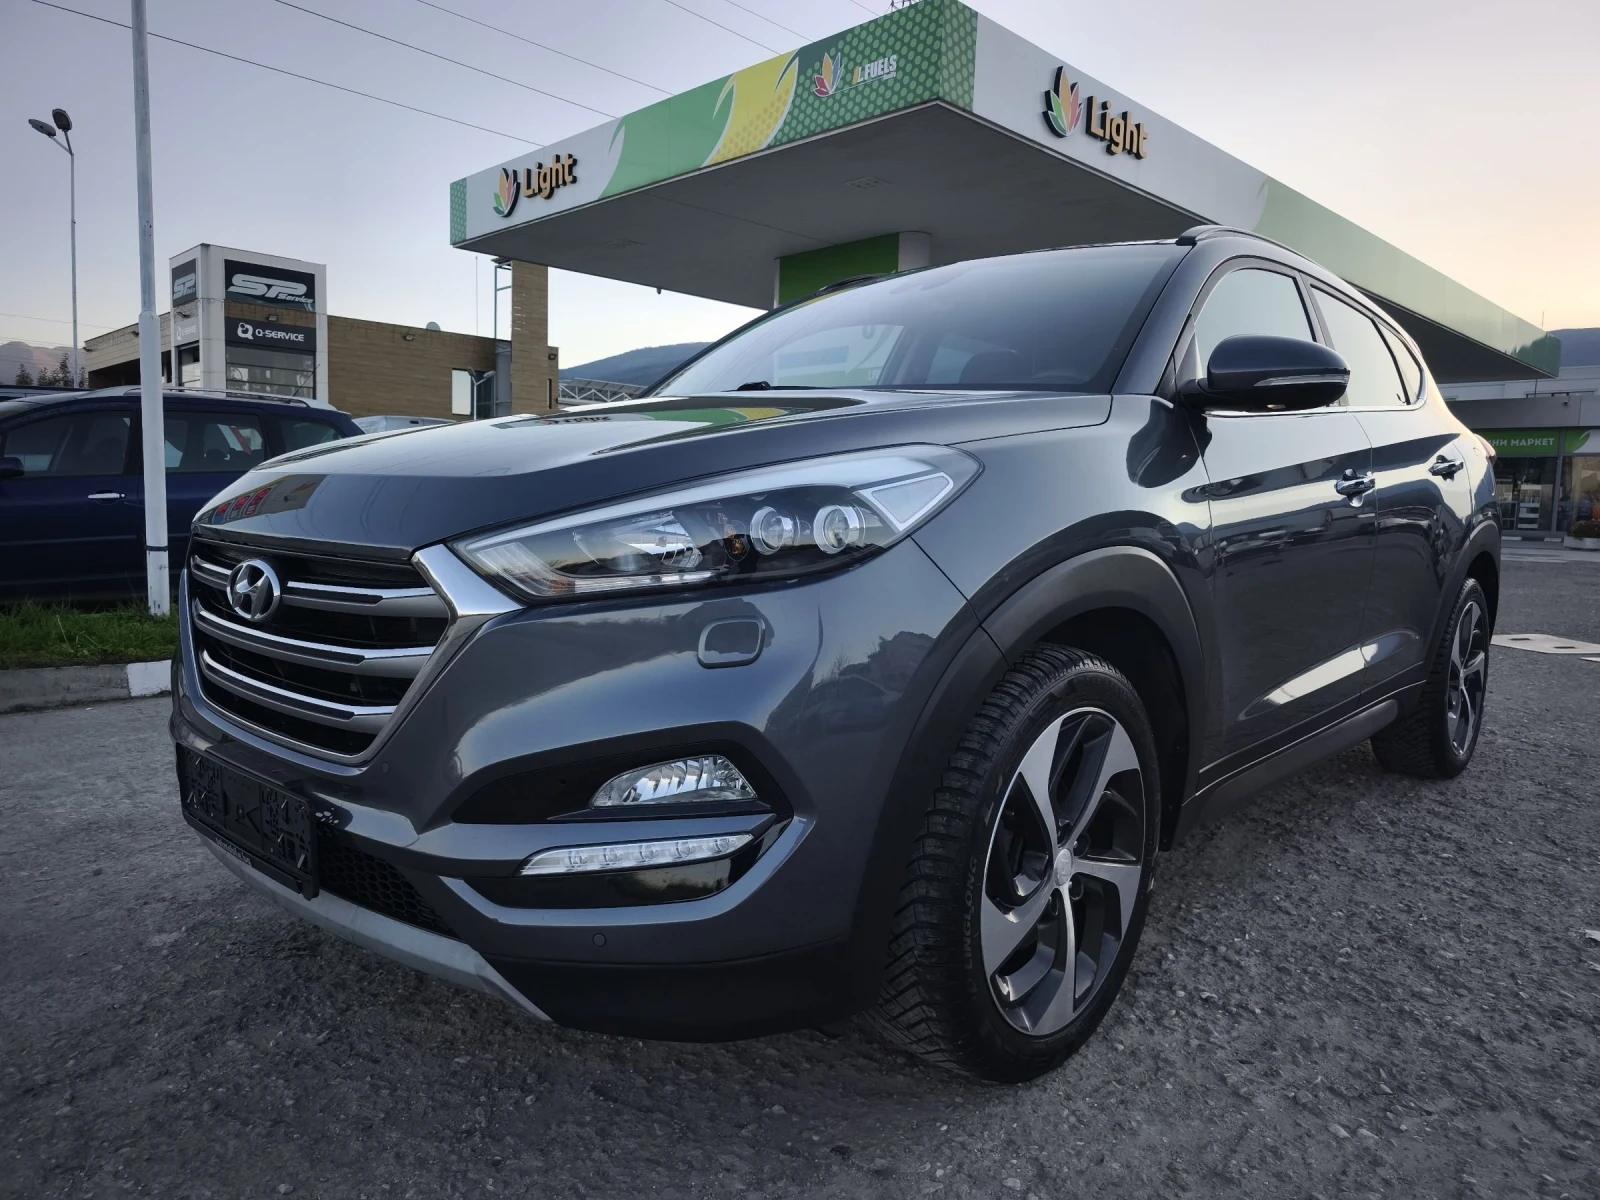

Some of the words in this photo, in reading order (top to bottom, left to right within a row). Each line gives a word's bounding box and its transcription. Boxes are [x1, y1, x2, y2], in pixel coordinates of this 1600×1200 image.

[864, 54, 897, 80] FUELS
[1086, 95, 1149, 160] Light
[523, 153, 577, 199] Light
[173, 272, 196, 300] SP
[227, 273, 308, 299] SP
[277, 292, 314, 304] Service
[255, 328, 305, 342] Q-SERVICE
[1511, 438, 1555, 447] МАРКЕТ
[962, 855, 978, 970] LINGLONG
